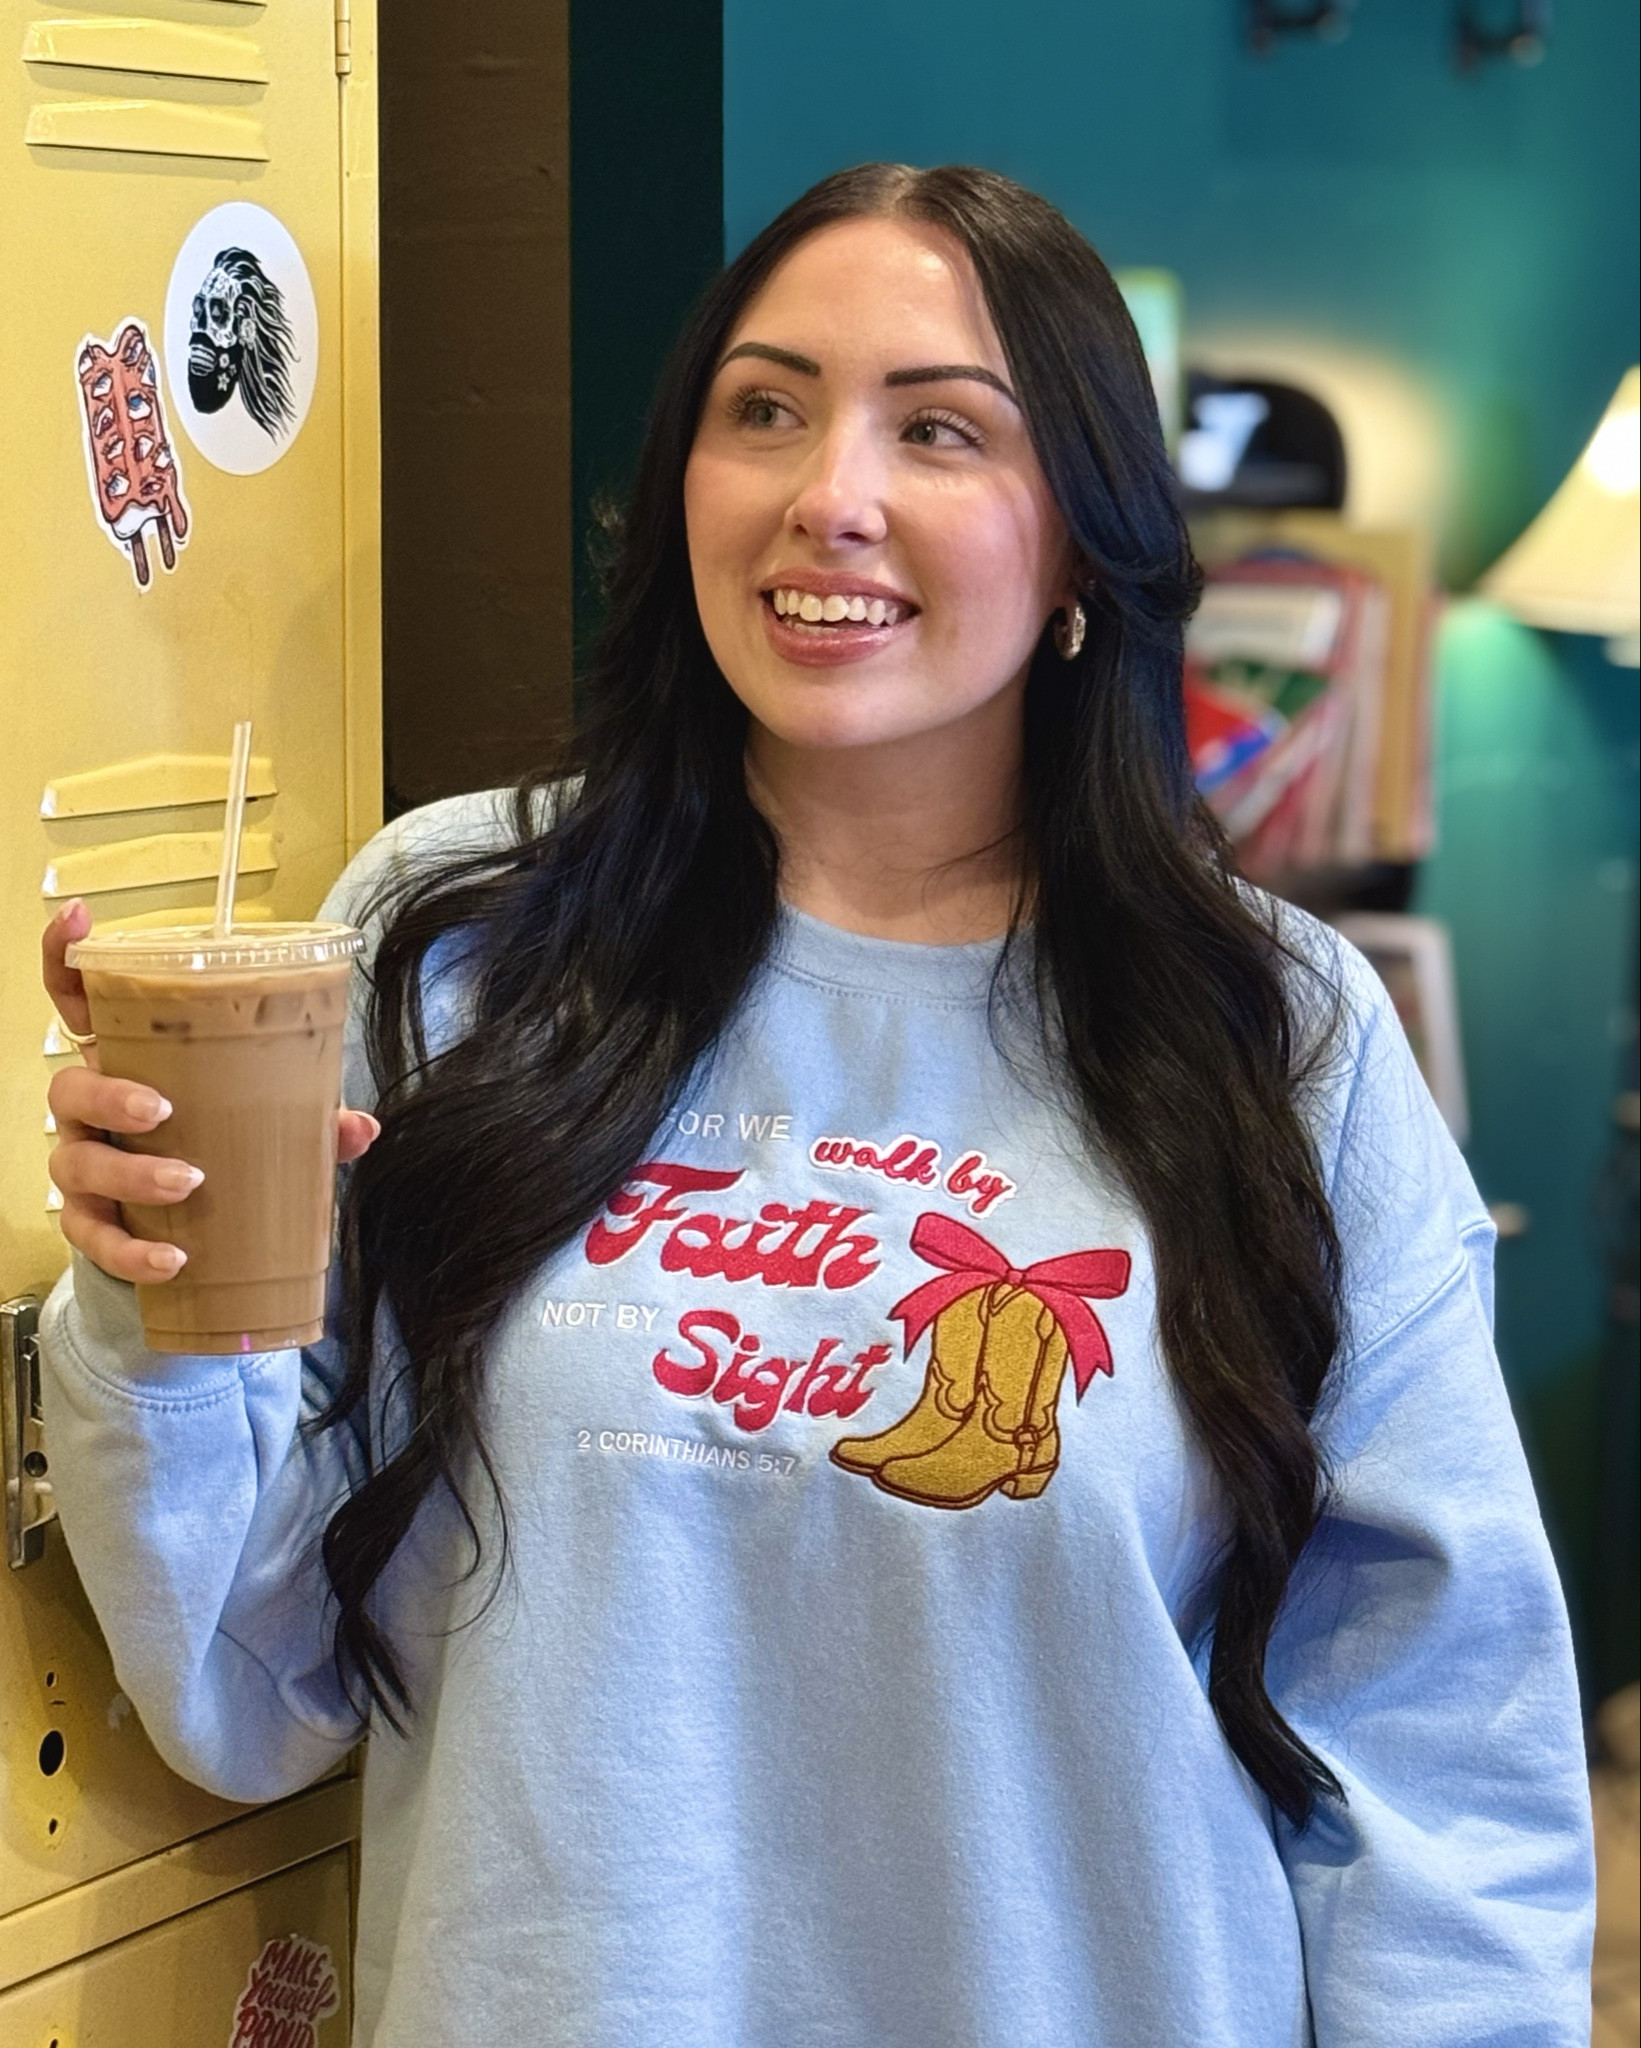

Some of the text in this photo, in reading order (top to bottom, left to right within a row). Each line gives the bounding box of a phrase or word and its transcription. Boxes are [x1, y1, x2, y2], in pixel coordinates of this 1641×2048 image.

[667, 1107, 1016, 1218] OR WE walk by
[585, 1162, 883, 1291] Faith
[541, 1301, 892, 1434] NOT BY Sight
[577, 1430, 796, 1476] 2 CORINTHIANS 5:7
[259, 1939, 328, 1988] MAKE
